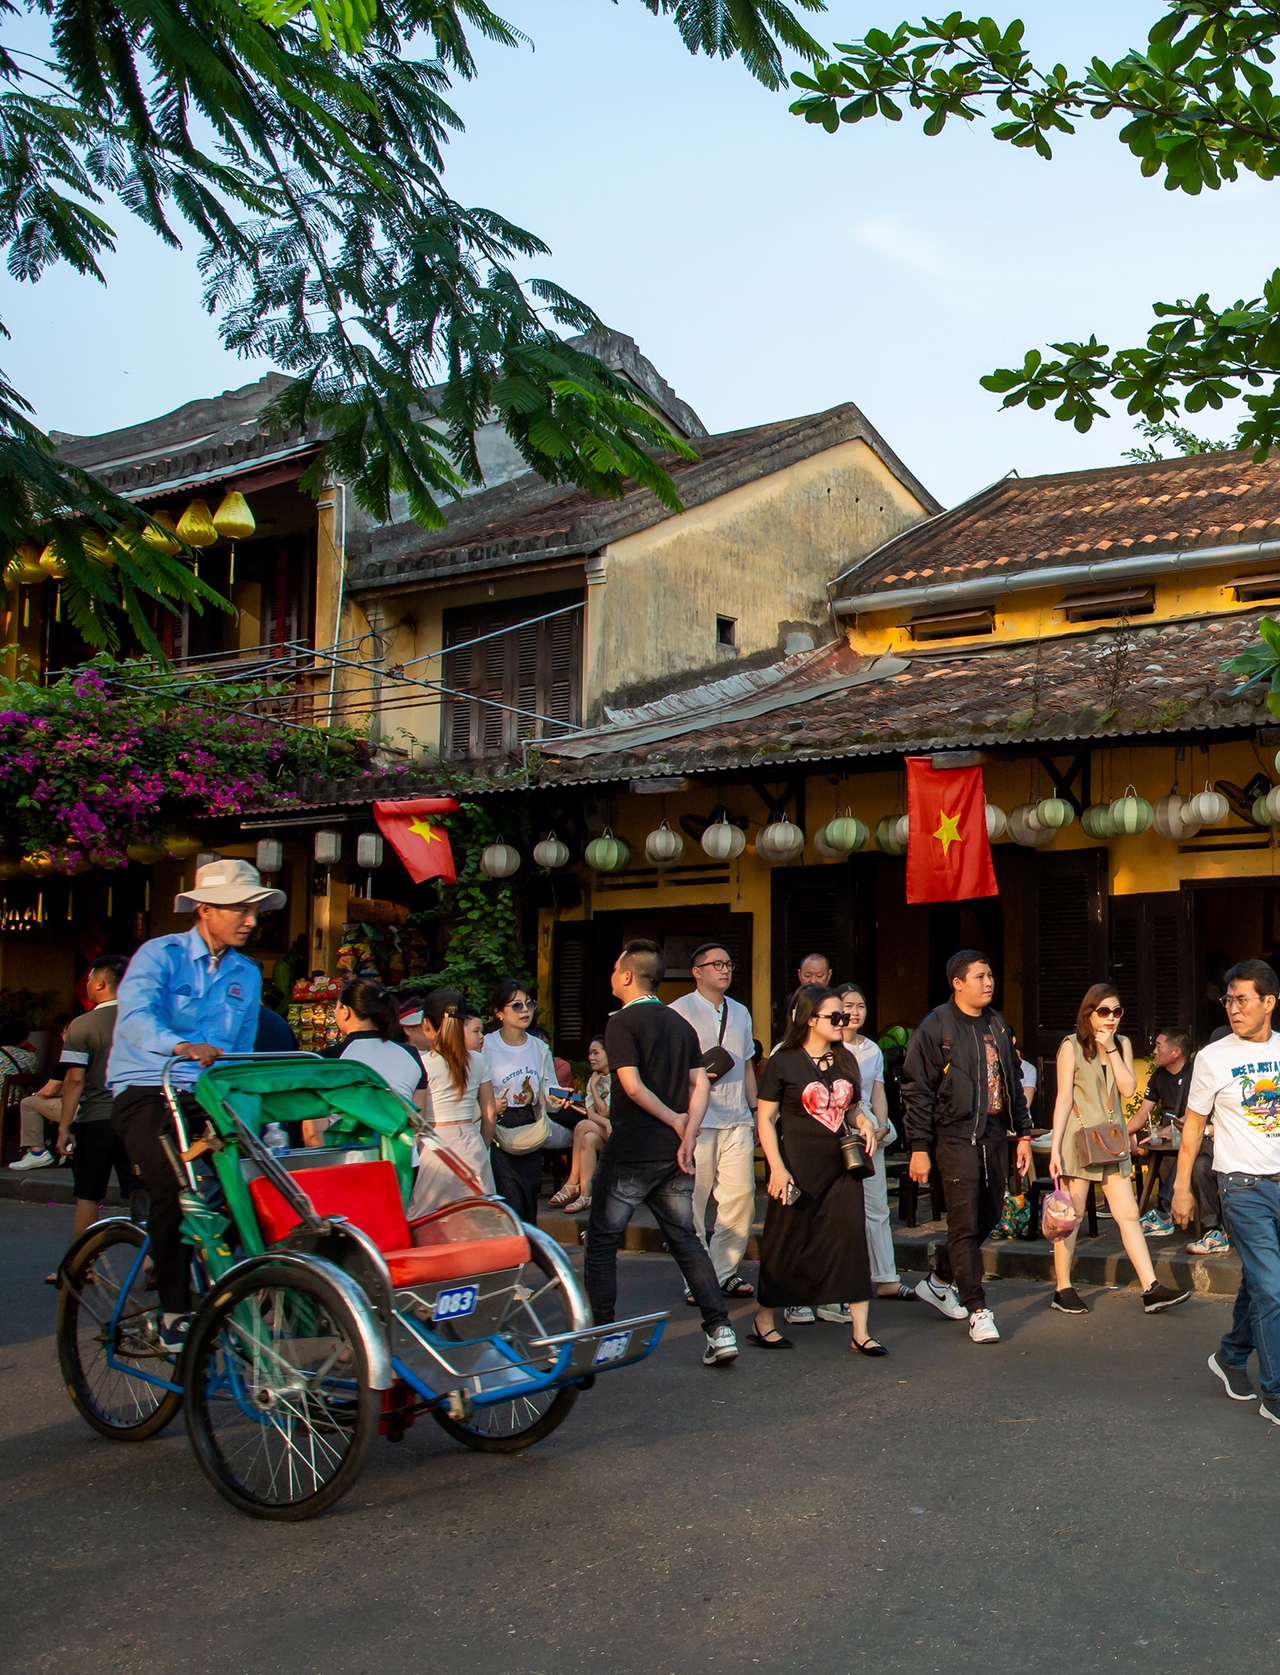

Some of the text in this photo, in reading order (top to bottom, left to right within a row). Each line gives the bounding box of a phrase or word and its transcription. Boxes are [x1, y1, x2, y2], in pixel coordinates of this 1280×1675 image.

[1247, 1063, 1255, 1074] IS
[1257, 1061, 1272, 1073] JUST
[1274, 1061, 1280, 1072] A
[502, 1069, 523, 1084] carrot
[438, 1291, 474, 1315] 083
